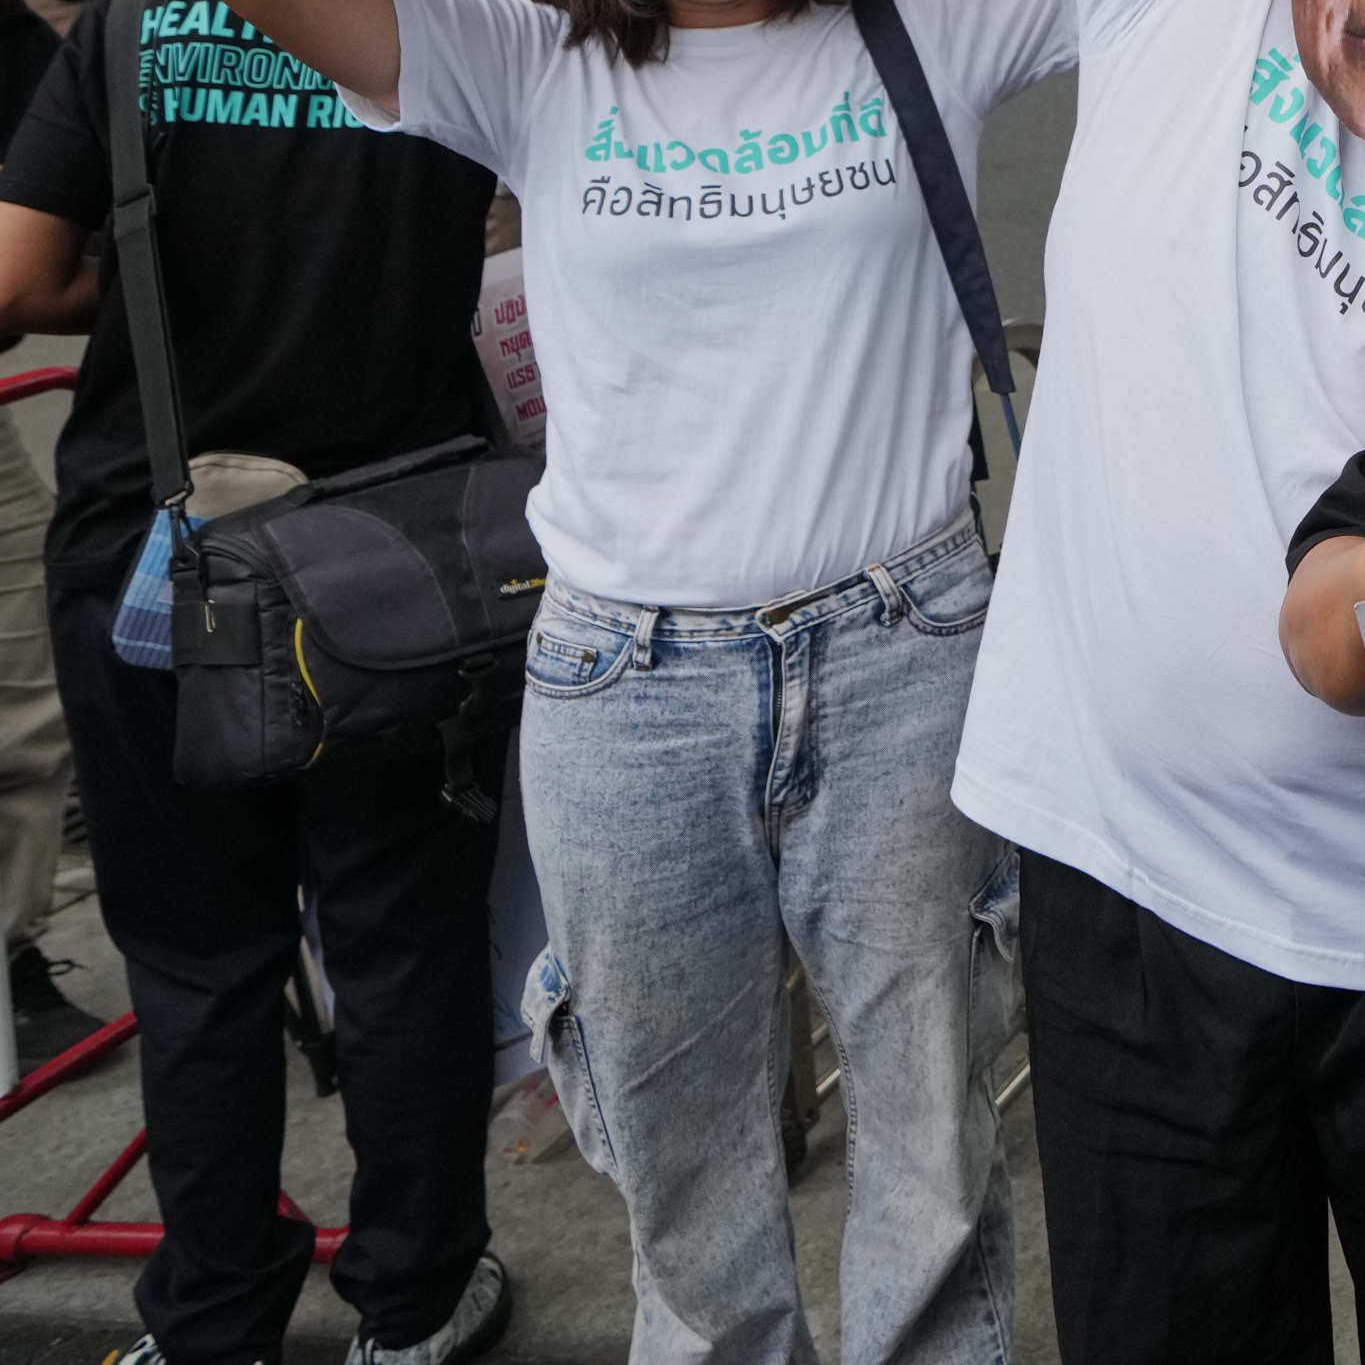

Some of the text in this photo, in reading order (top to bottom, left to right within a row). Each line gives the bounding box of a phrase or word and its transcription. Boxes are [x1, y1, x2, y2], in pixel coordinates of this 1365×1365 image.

[140, 0, 273, 45] HEAL
[163, 87, 298, 128] HUMAN
[581, 158, 897, 221] คือสิทธิมนุษยชน
